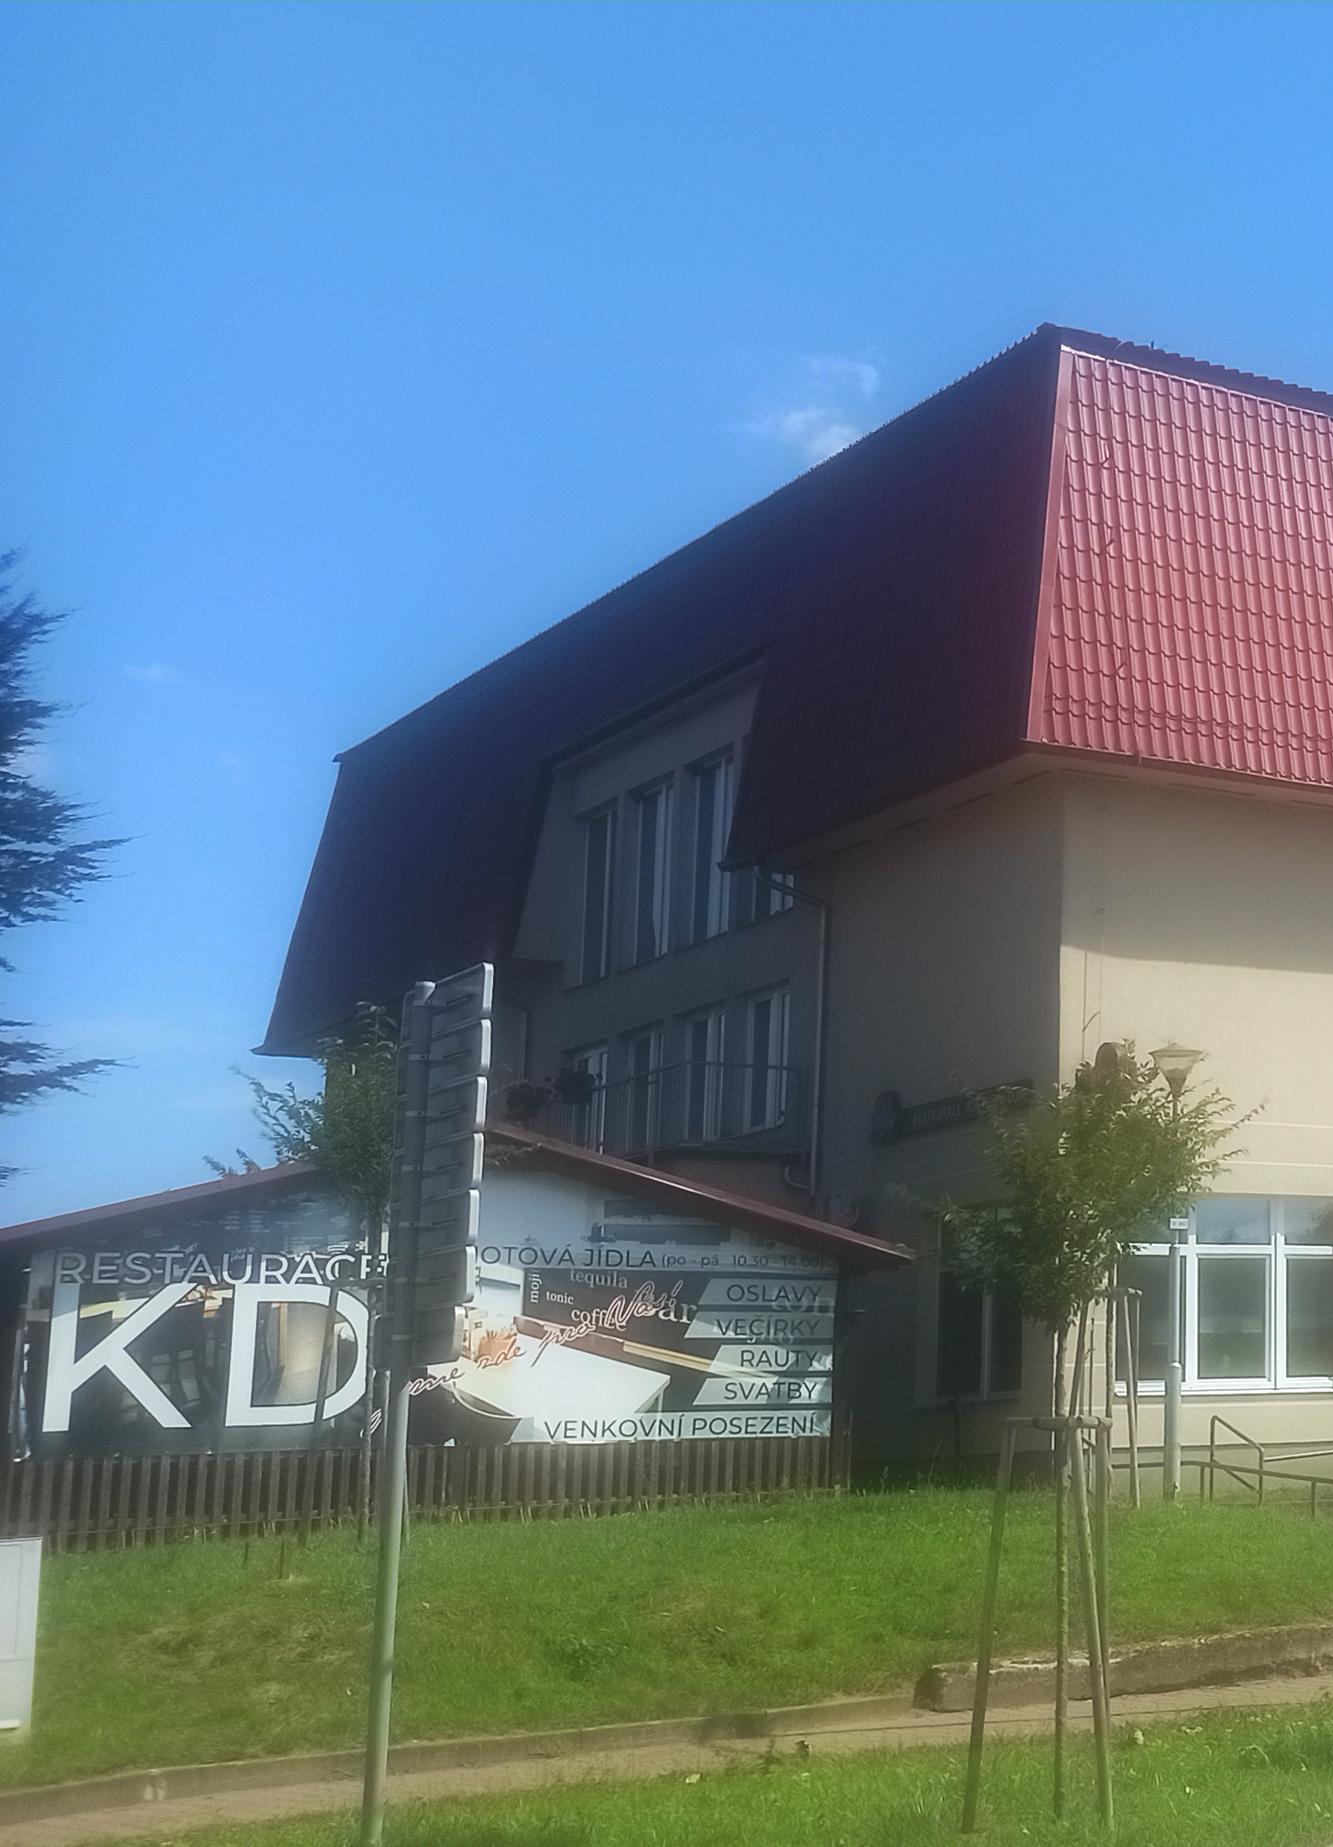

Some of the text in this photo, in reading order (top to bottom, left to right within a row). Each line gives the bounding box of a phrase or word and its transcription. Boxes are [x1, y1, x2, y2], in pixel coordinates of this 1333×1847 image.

[582, 1242, 656, 1268] JÍDLA
[662, 1255, 687, 1268] (po
[701, 1254, 719, 1269] pá
[570, 1268, 628, 1289] tequila
[546, 1290, 574, 1306] tonic
[726, 1283, 822, 1303] OSLAVY
[716, 1314, 821, 1336] VEČÍRKY
[477, 1344, 528, 1370] zde
[532, 1320, 596, 1368] pro
[42, 1282, 369, 1432] KD
[740, 1349, 818, 1368] RAUTY
[724, 1381, 818, 1401] SVATBY
[544, 1411, 816, 1439] VENKOVNÍ POSEZENÍ
